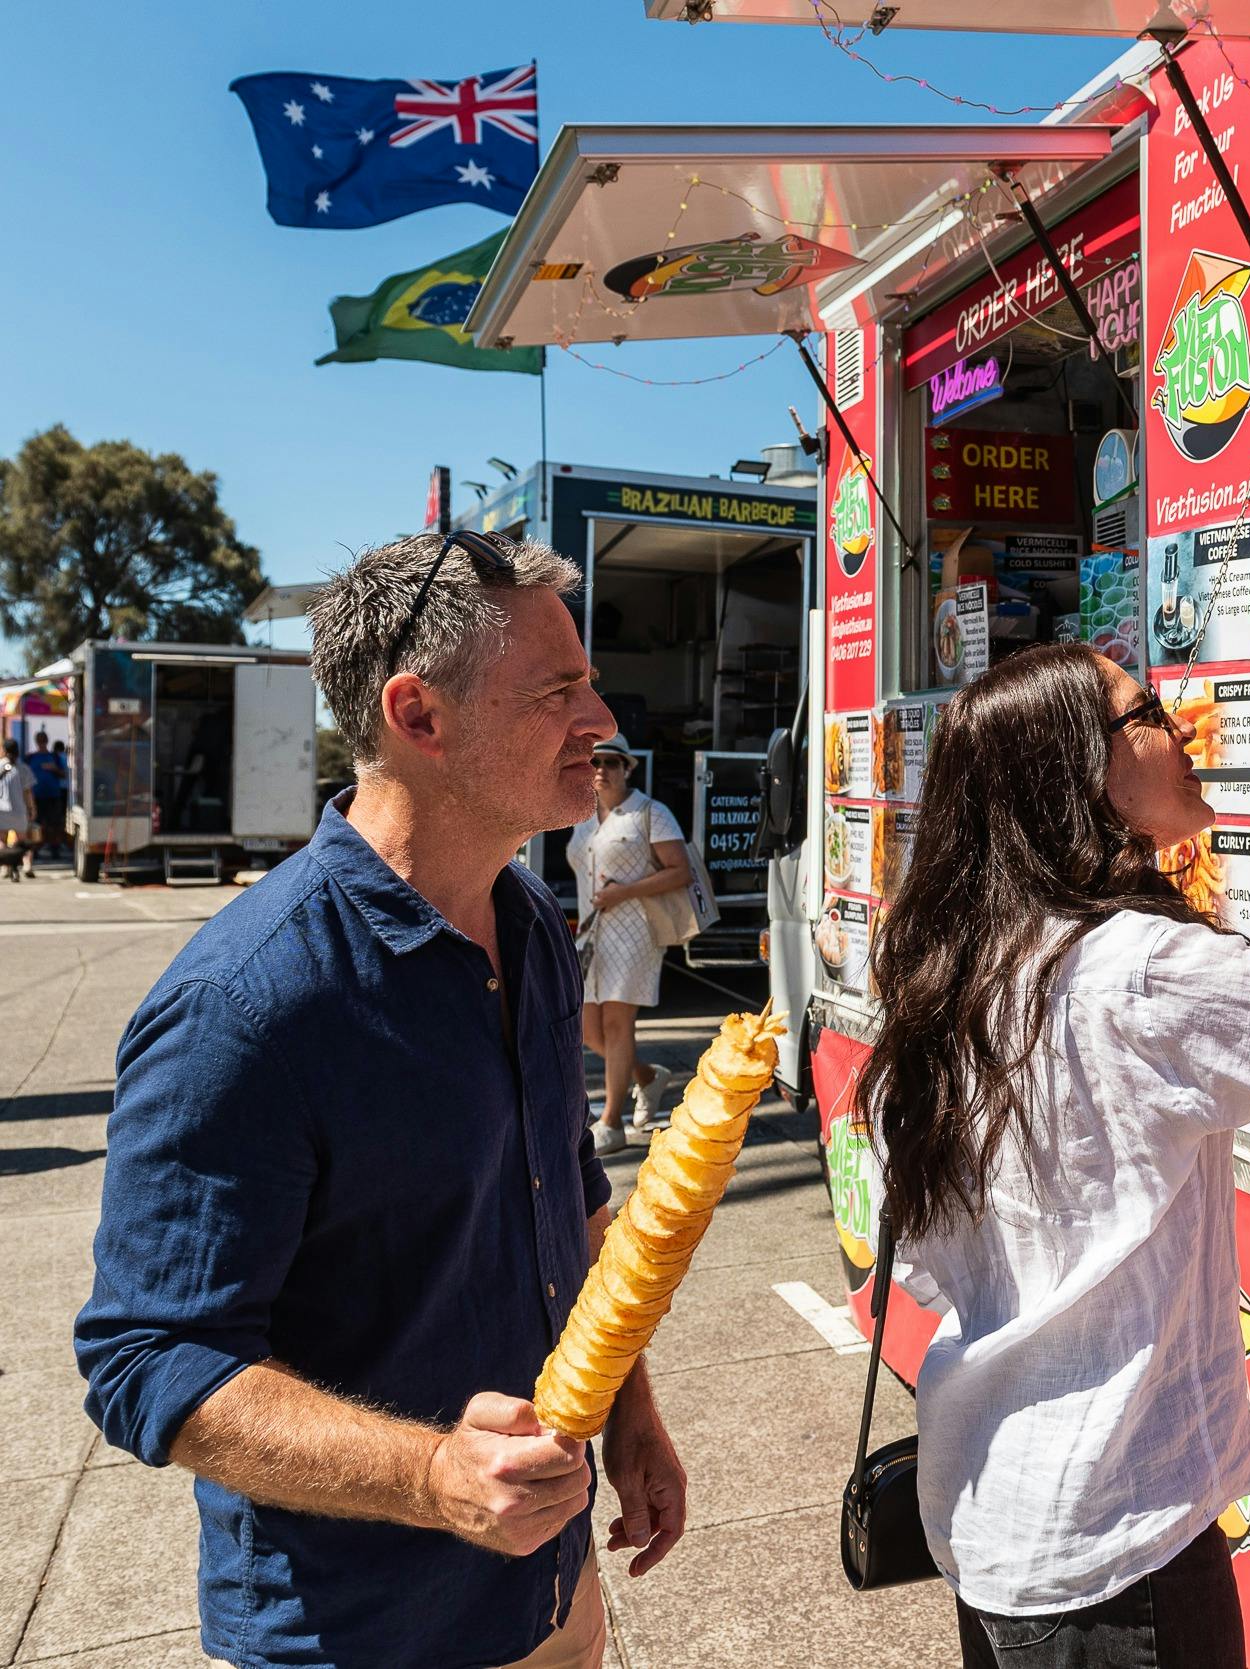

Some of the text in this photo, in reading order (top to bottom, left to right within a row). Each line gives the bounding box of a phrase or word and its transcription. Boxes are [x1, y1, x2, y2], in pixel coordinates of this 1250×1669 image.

[1213, 73, 1235, 109] Us
[1174, 150, 1198, 184] For
[956, 278, 1018, 352] ORDER
[930, 356, 999, 413] Welcome
[962, 443, 1050, 471] ORDER
[975, 484, 1040, 509] HERE
[621, 487, 796, 525] BRAZILIAN BARBECUE
[1016, 538, 1068, 548] VERMICELLI
[1009, 560, 1032, 568] COLD
[1225, 605, 1240, 616] Large
[1218, 684, 1243, 698] CRISPY
[1220, 717, 1241, 729] EXTRA
[1220, 733, 1235, 745] SKIN
[1236, 733, 1247, 744] ON
[711, 797, 748, 807] CATERING
[711, 833, 740, 852] 0415
[1218, 837, 1245, 851] CURLY
